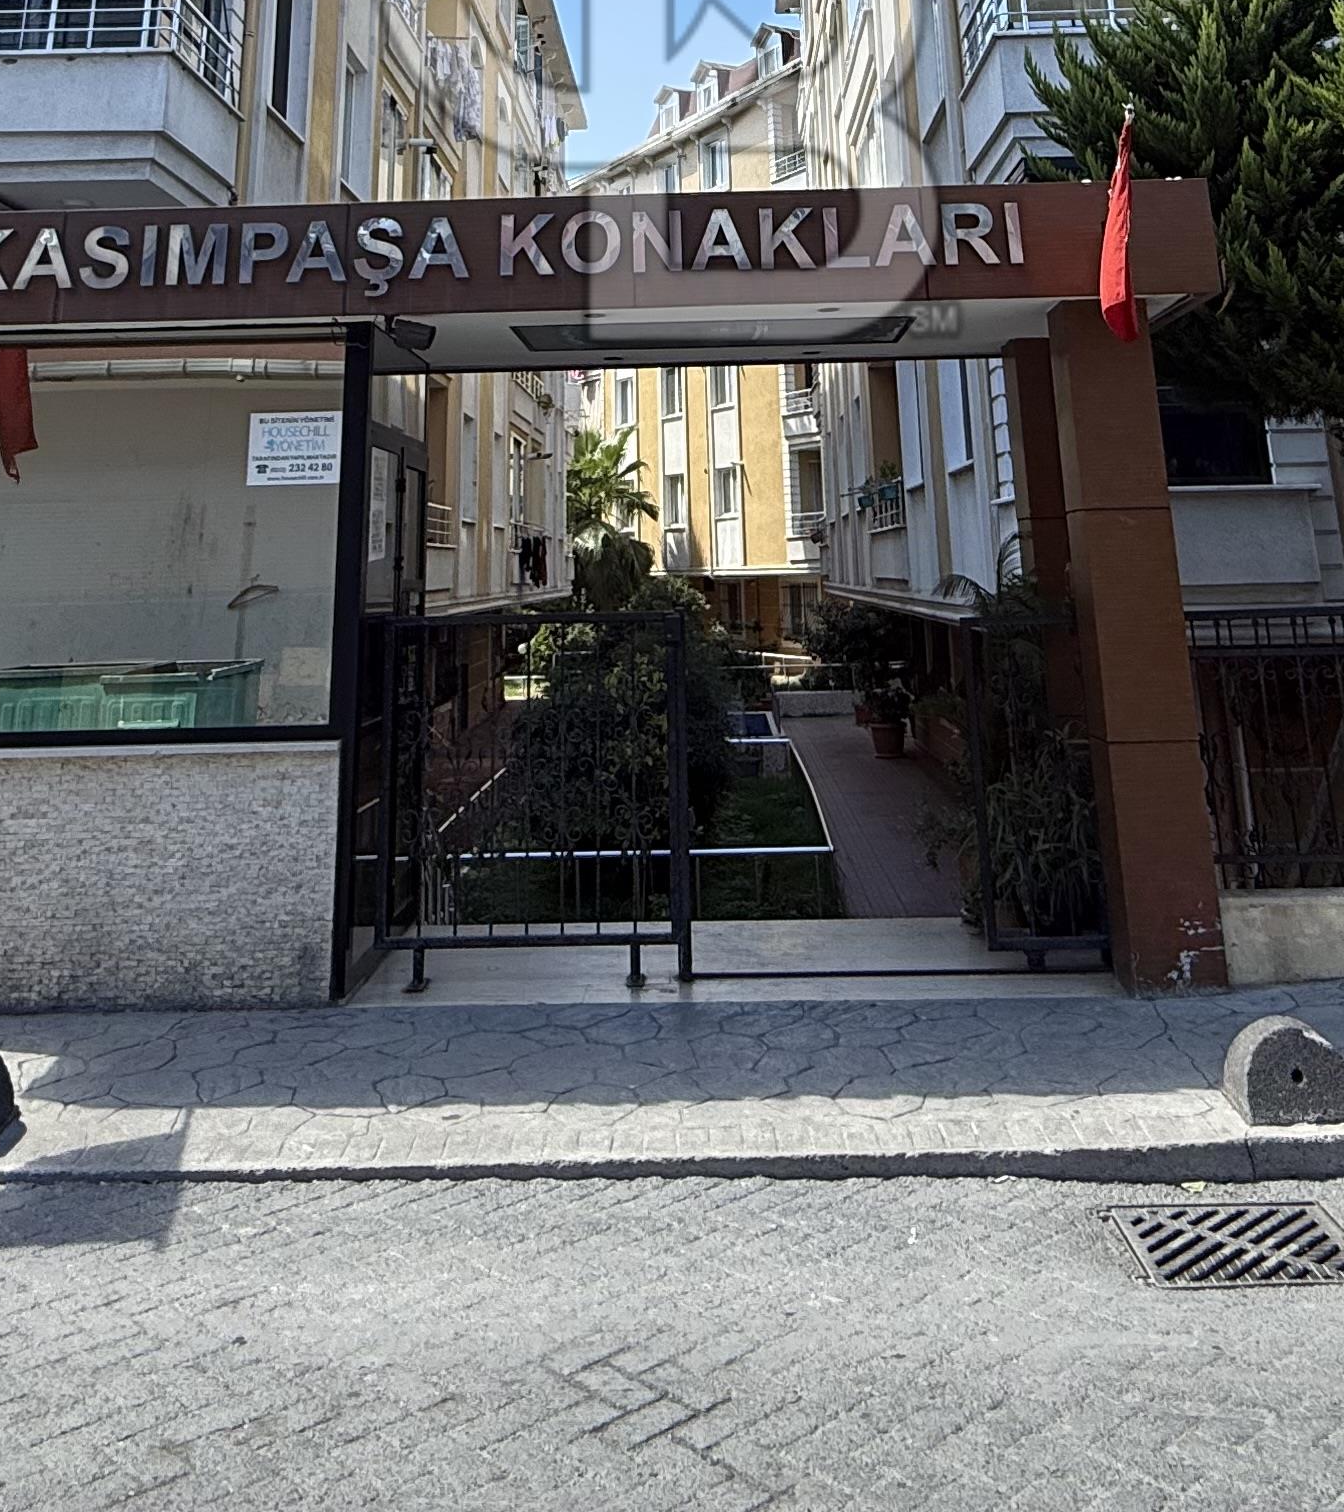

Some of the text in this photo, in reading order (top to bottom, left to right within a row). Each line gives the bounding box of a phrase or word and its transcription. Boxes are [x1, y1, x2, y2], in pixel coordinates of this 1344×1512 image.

[499, 201, 1024, 277] KONAKLARI
[288, 463, 306, 473] 232
[308, 463, 320, 472] 42
[321, 462, 333, 472] 80
